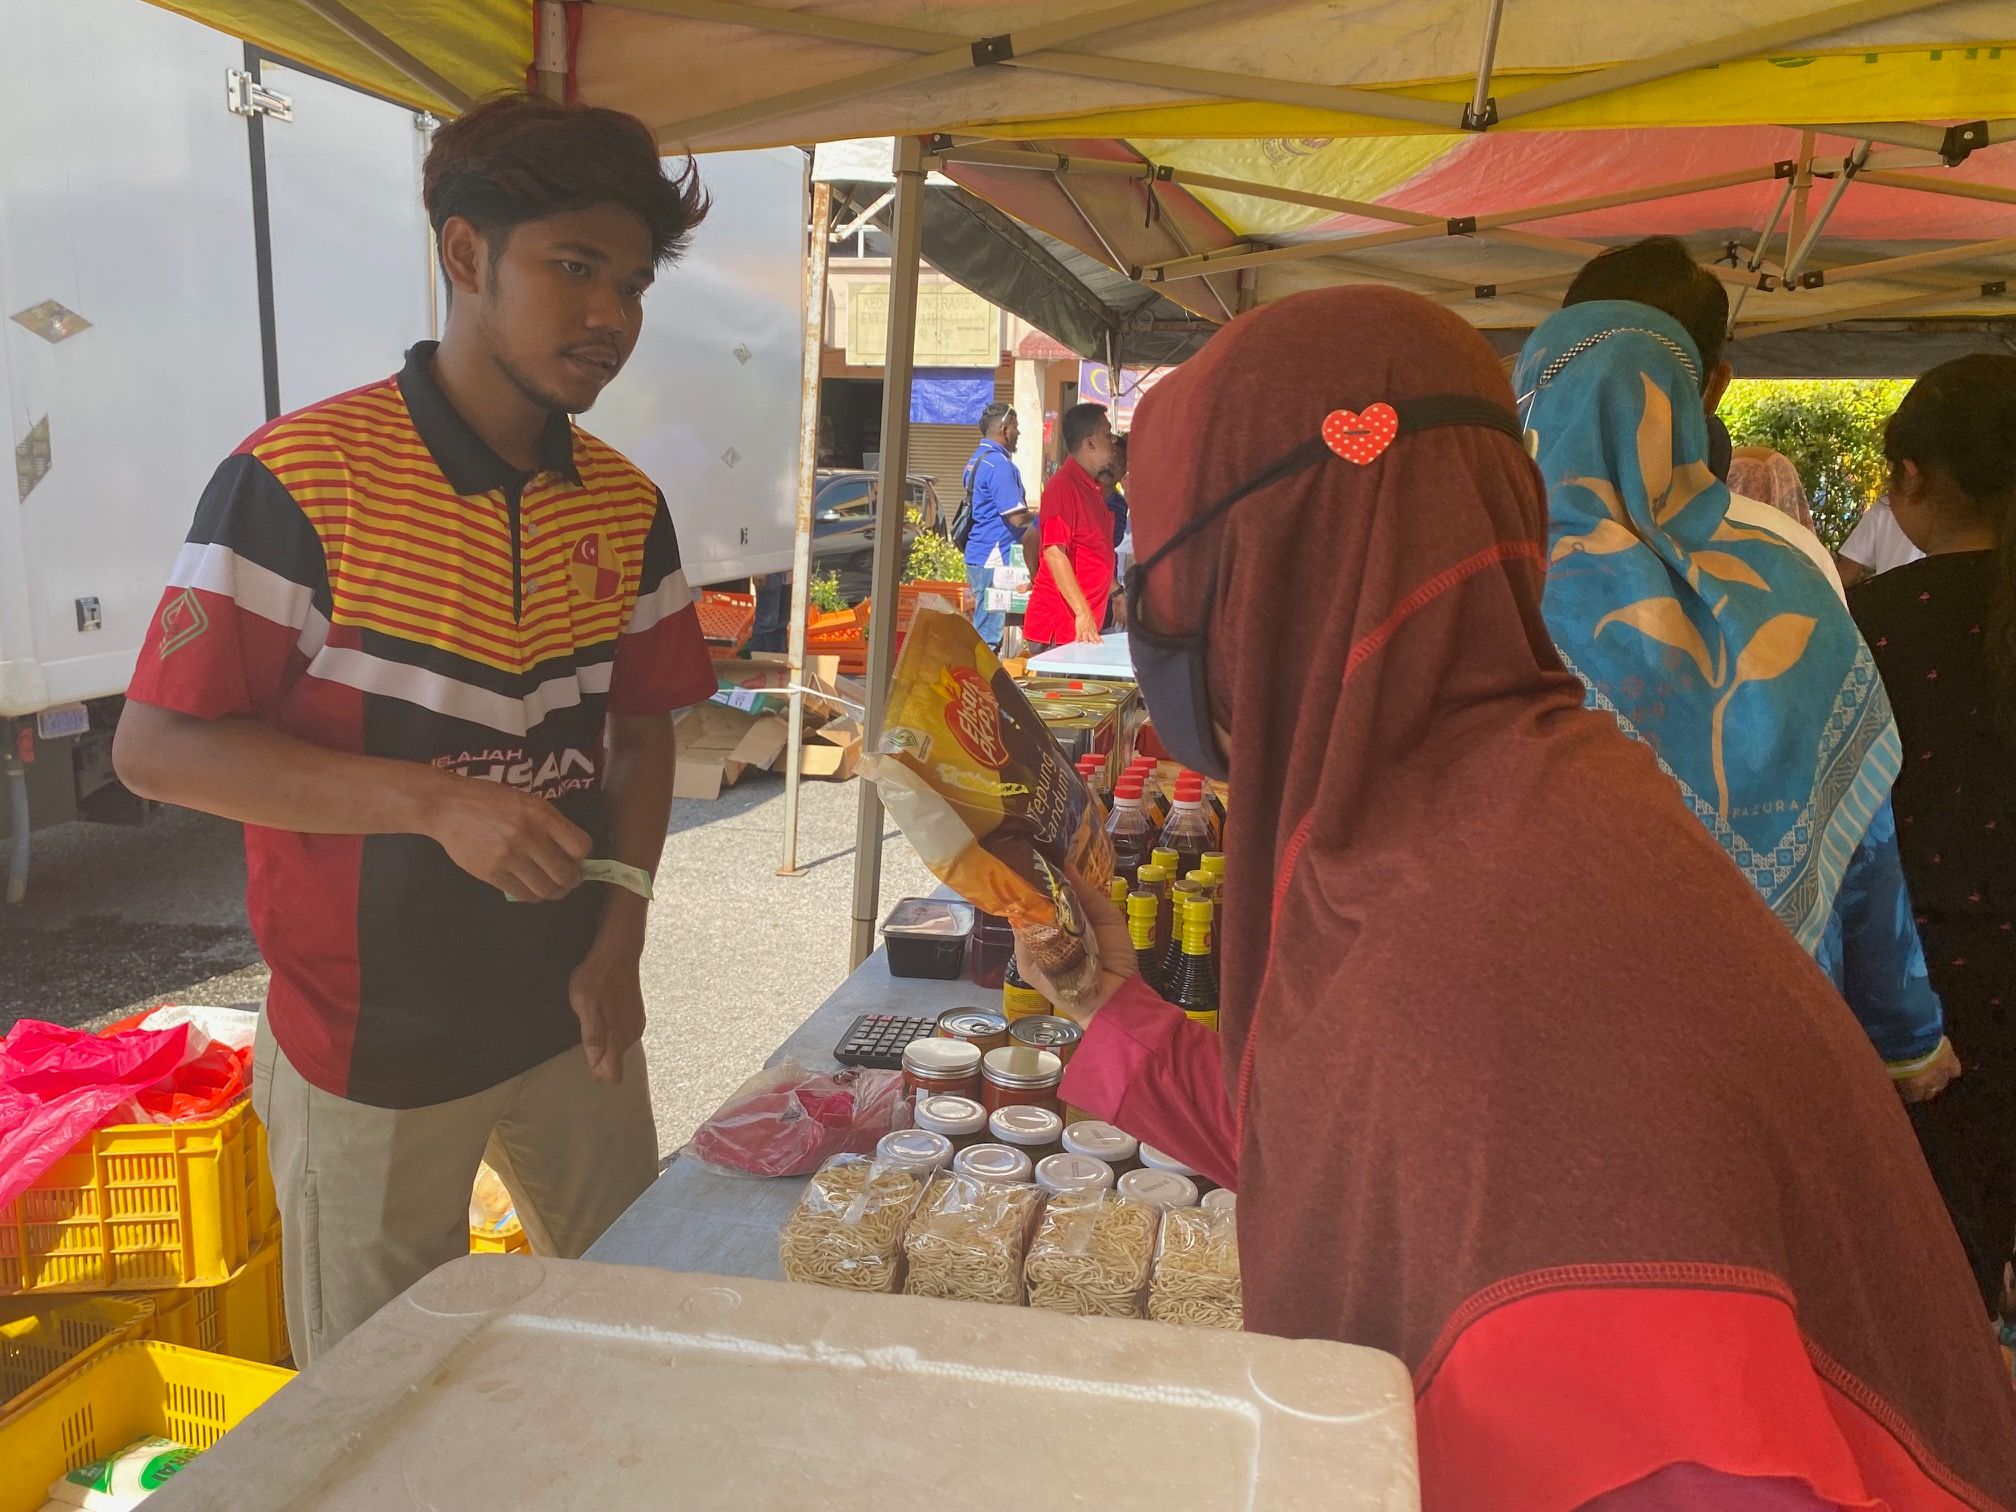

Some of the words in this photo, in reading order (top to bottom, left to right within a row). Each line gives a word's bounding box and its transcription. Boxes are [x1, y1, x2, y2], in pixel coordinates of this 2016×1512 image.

[956, 678, 981, 746] Ehsan
[450, 747, 595, 793] HSAN
[1025, 751, 1057, 823] Tepung
[1033, 767, 1071, 844] Gandum
